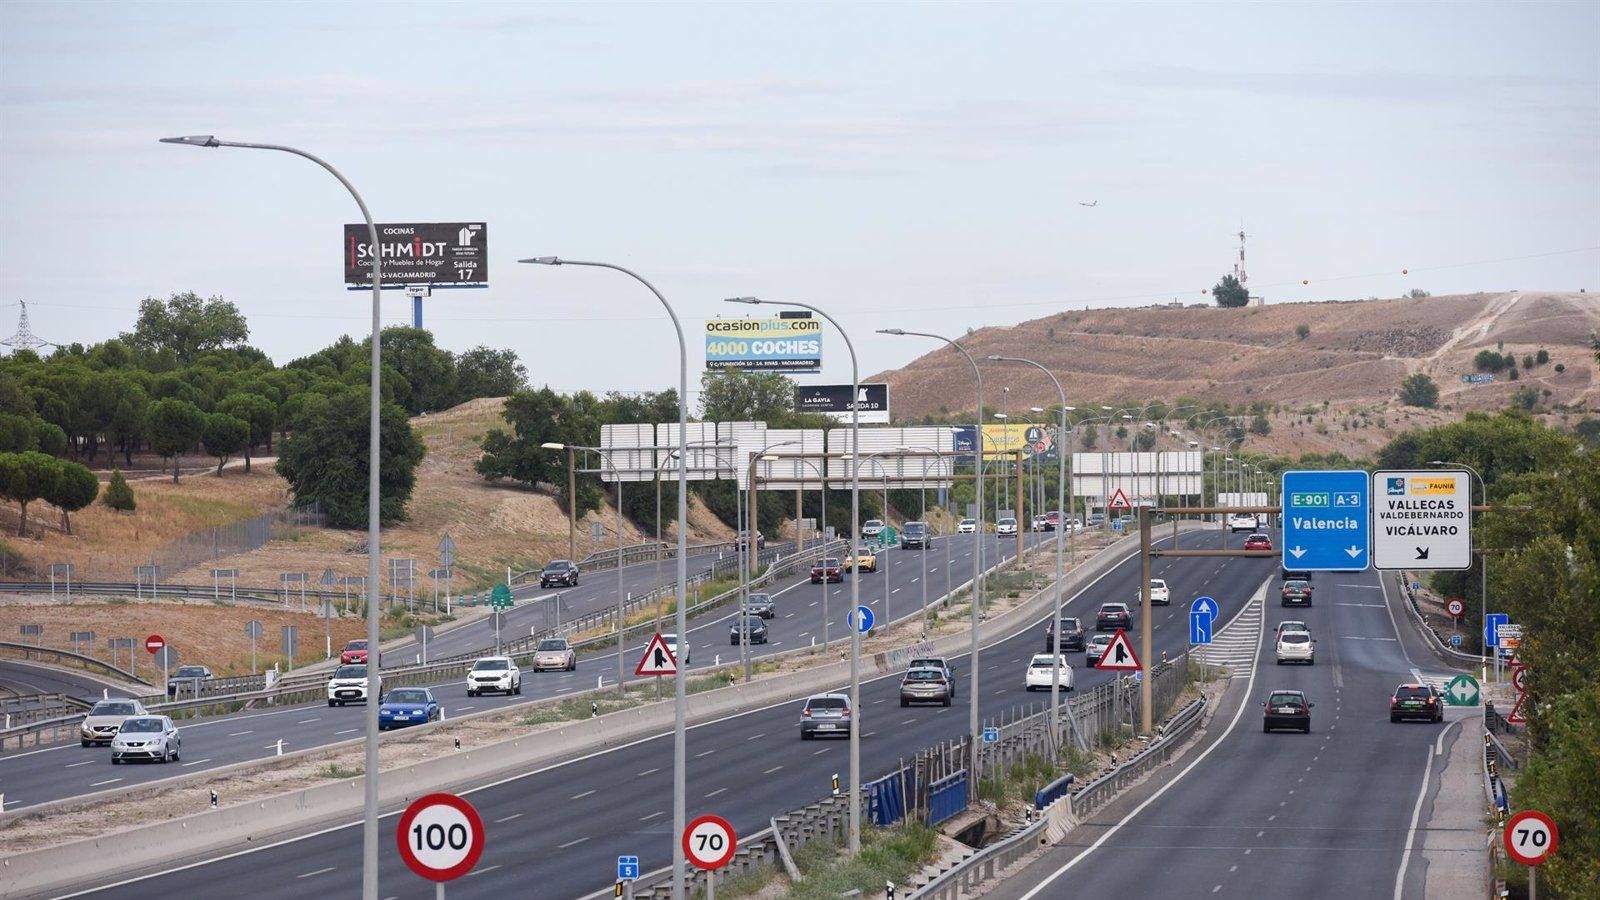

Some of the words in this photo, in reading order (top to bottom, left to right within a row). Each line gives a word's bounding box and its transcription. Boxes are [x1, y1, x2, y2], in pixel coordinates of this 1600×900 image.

[383, 227, 415, 235] COCINAS
[425, 259, 445, 267] Hogar
[458, 269, 473, 280] 17
[706, 320, 819, 332] ocasionplus.com
[707, 341, 748, 355] 4000
[751, 340, 819, 355] COCHES
[846, 402, 870, 410] SAIDA
[1293, 495, 1328, 505] E-901
[1336, 495, 1359, 505] A-3
[1388, 500, 1455, 510] VALLECAS
[1380, 511, 1464, 520] VALDEBERNARDO
[1292, 517, 1358, 530] Valencia
[1386, 523, 1458, 536] VICÁLVARO
[413, 823, 467, 851] 100
[695, 834, 723, 851] 70
[1517, 829, 1546, 847] 70
[625, 866, 631, 876] 5
